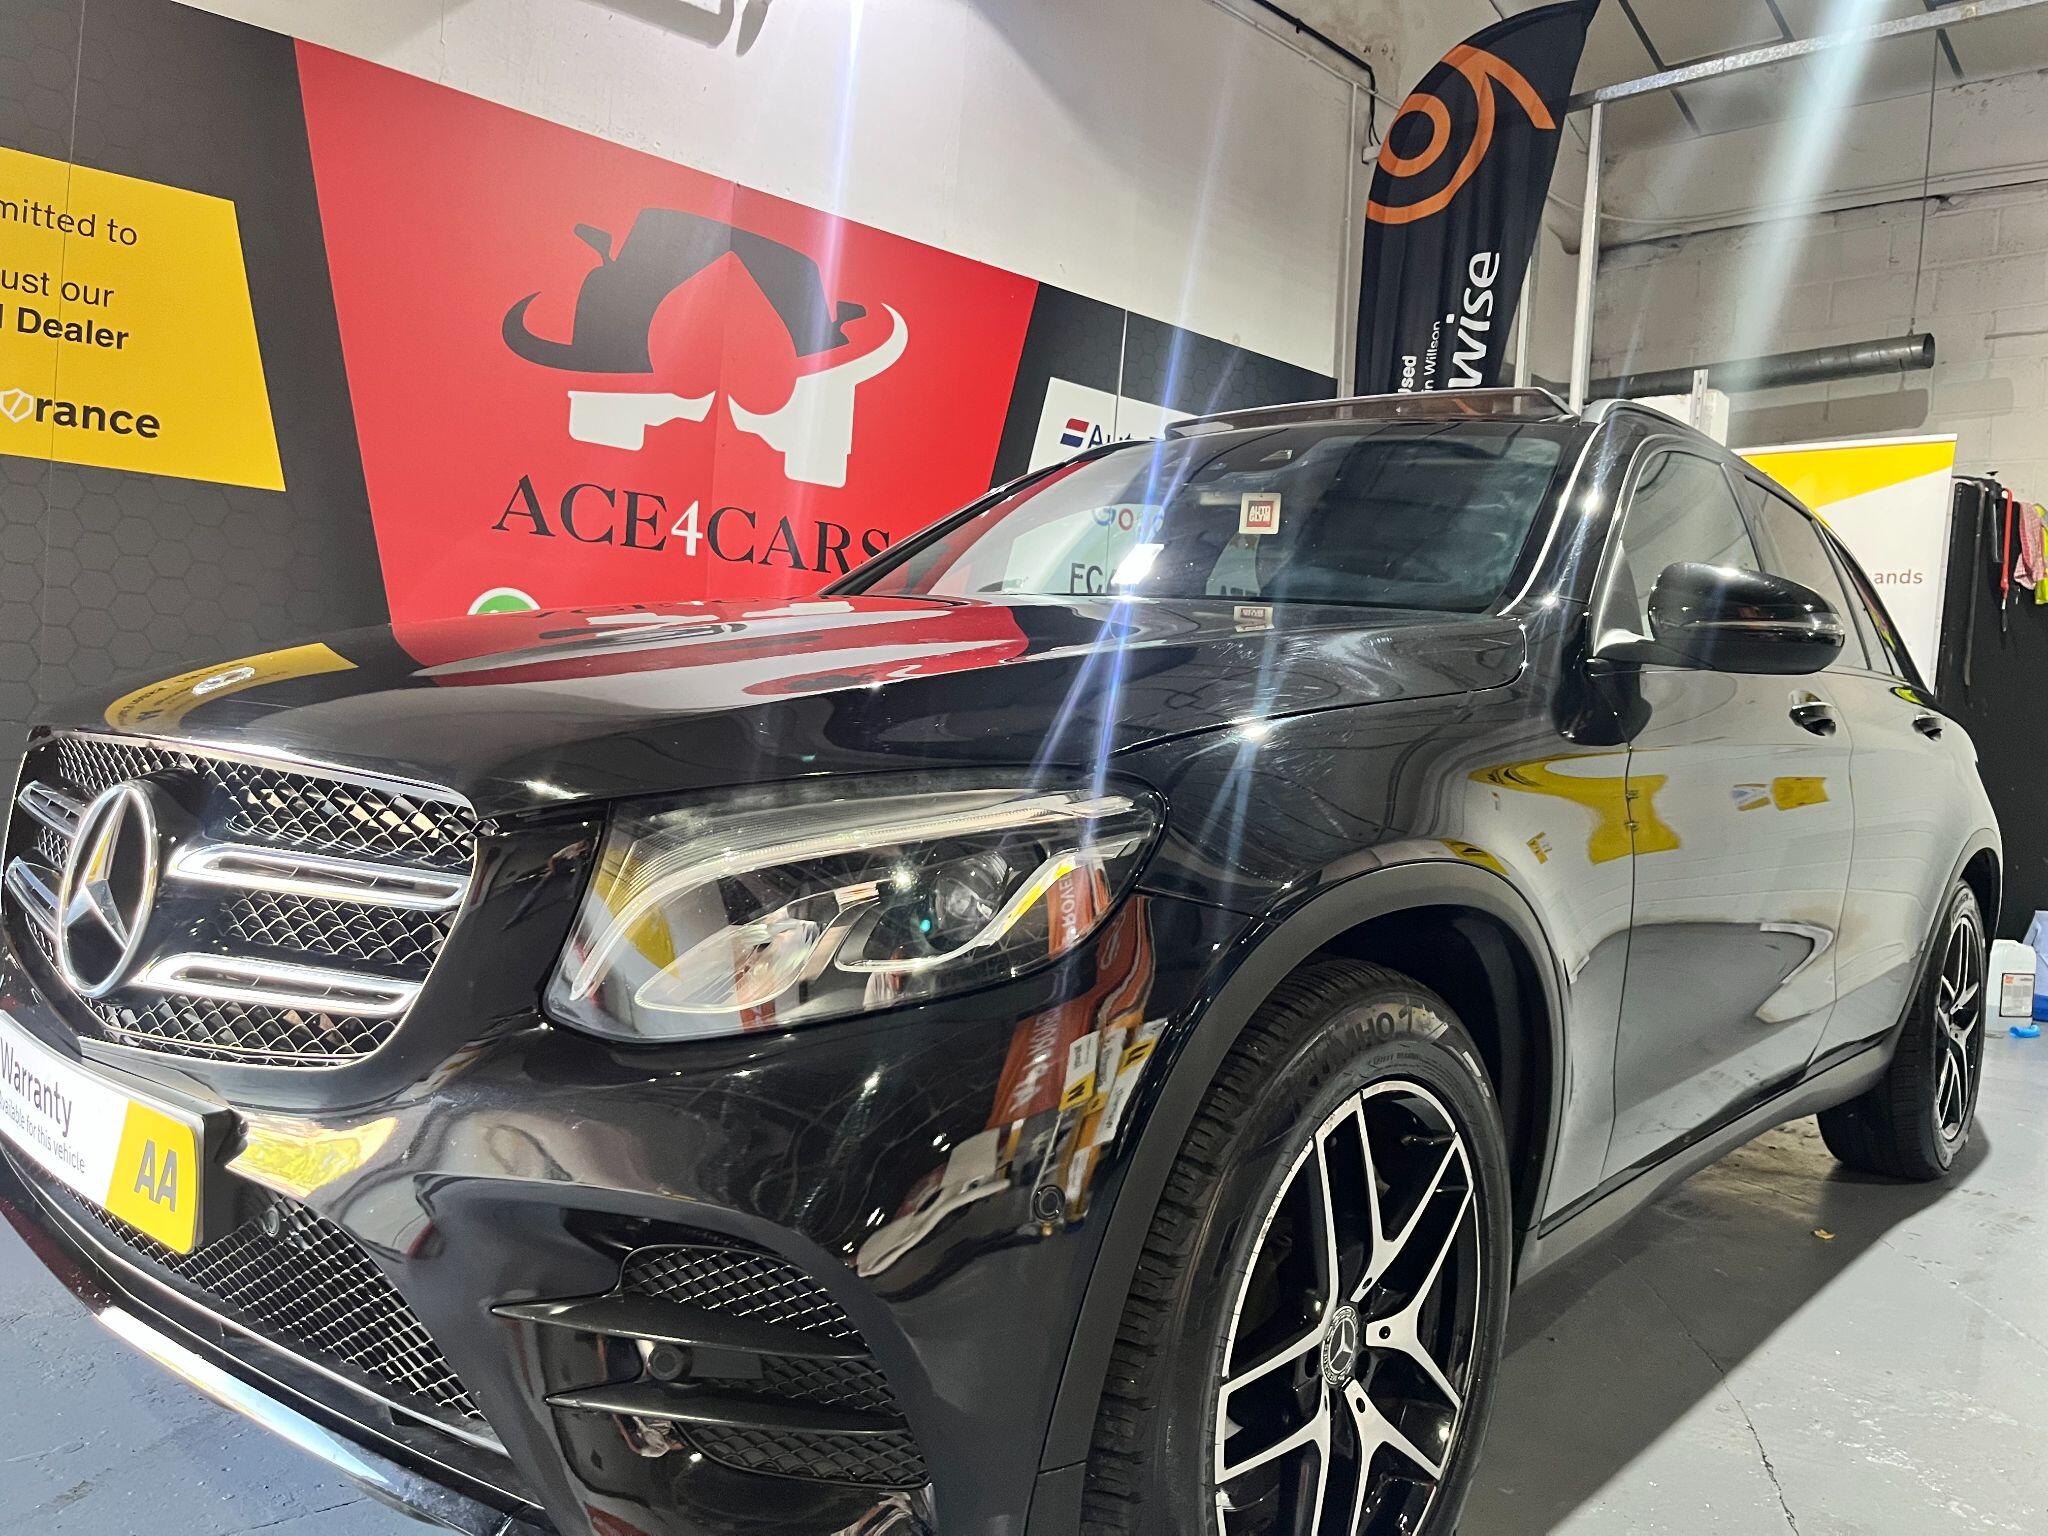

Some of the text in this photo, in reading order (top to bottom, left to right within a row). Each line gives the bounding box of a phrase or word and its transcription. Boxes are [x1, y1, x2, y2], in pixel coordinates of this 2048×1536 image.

[107, 218, 138, 246] to
[1, 269, 115, 307] ust our
[1446, 251, 1500, 389] wise
[17, 306, 129, 350] Dealer
[1423, 320, 1441, 376] Willson
[491, 474, 894, 575] ACE4CARS
[0, 1036, 72, 1138] Warranty
[0, 1089, 85, 1174] vailable for this vehicle
[133, 1138, 178, 1213] AA
